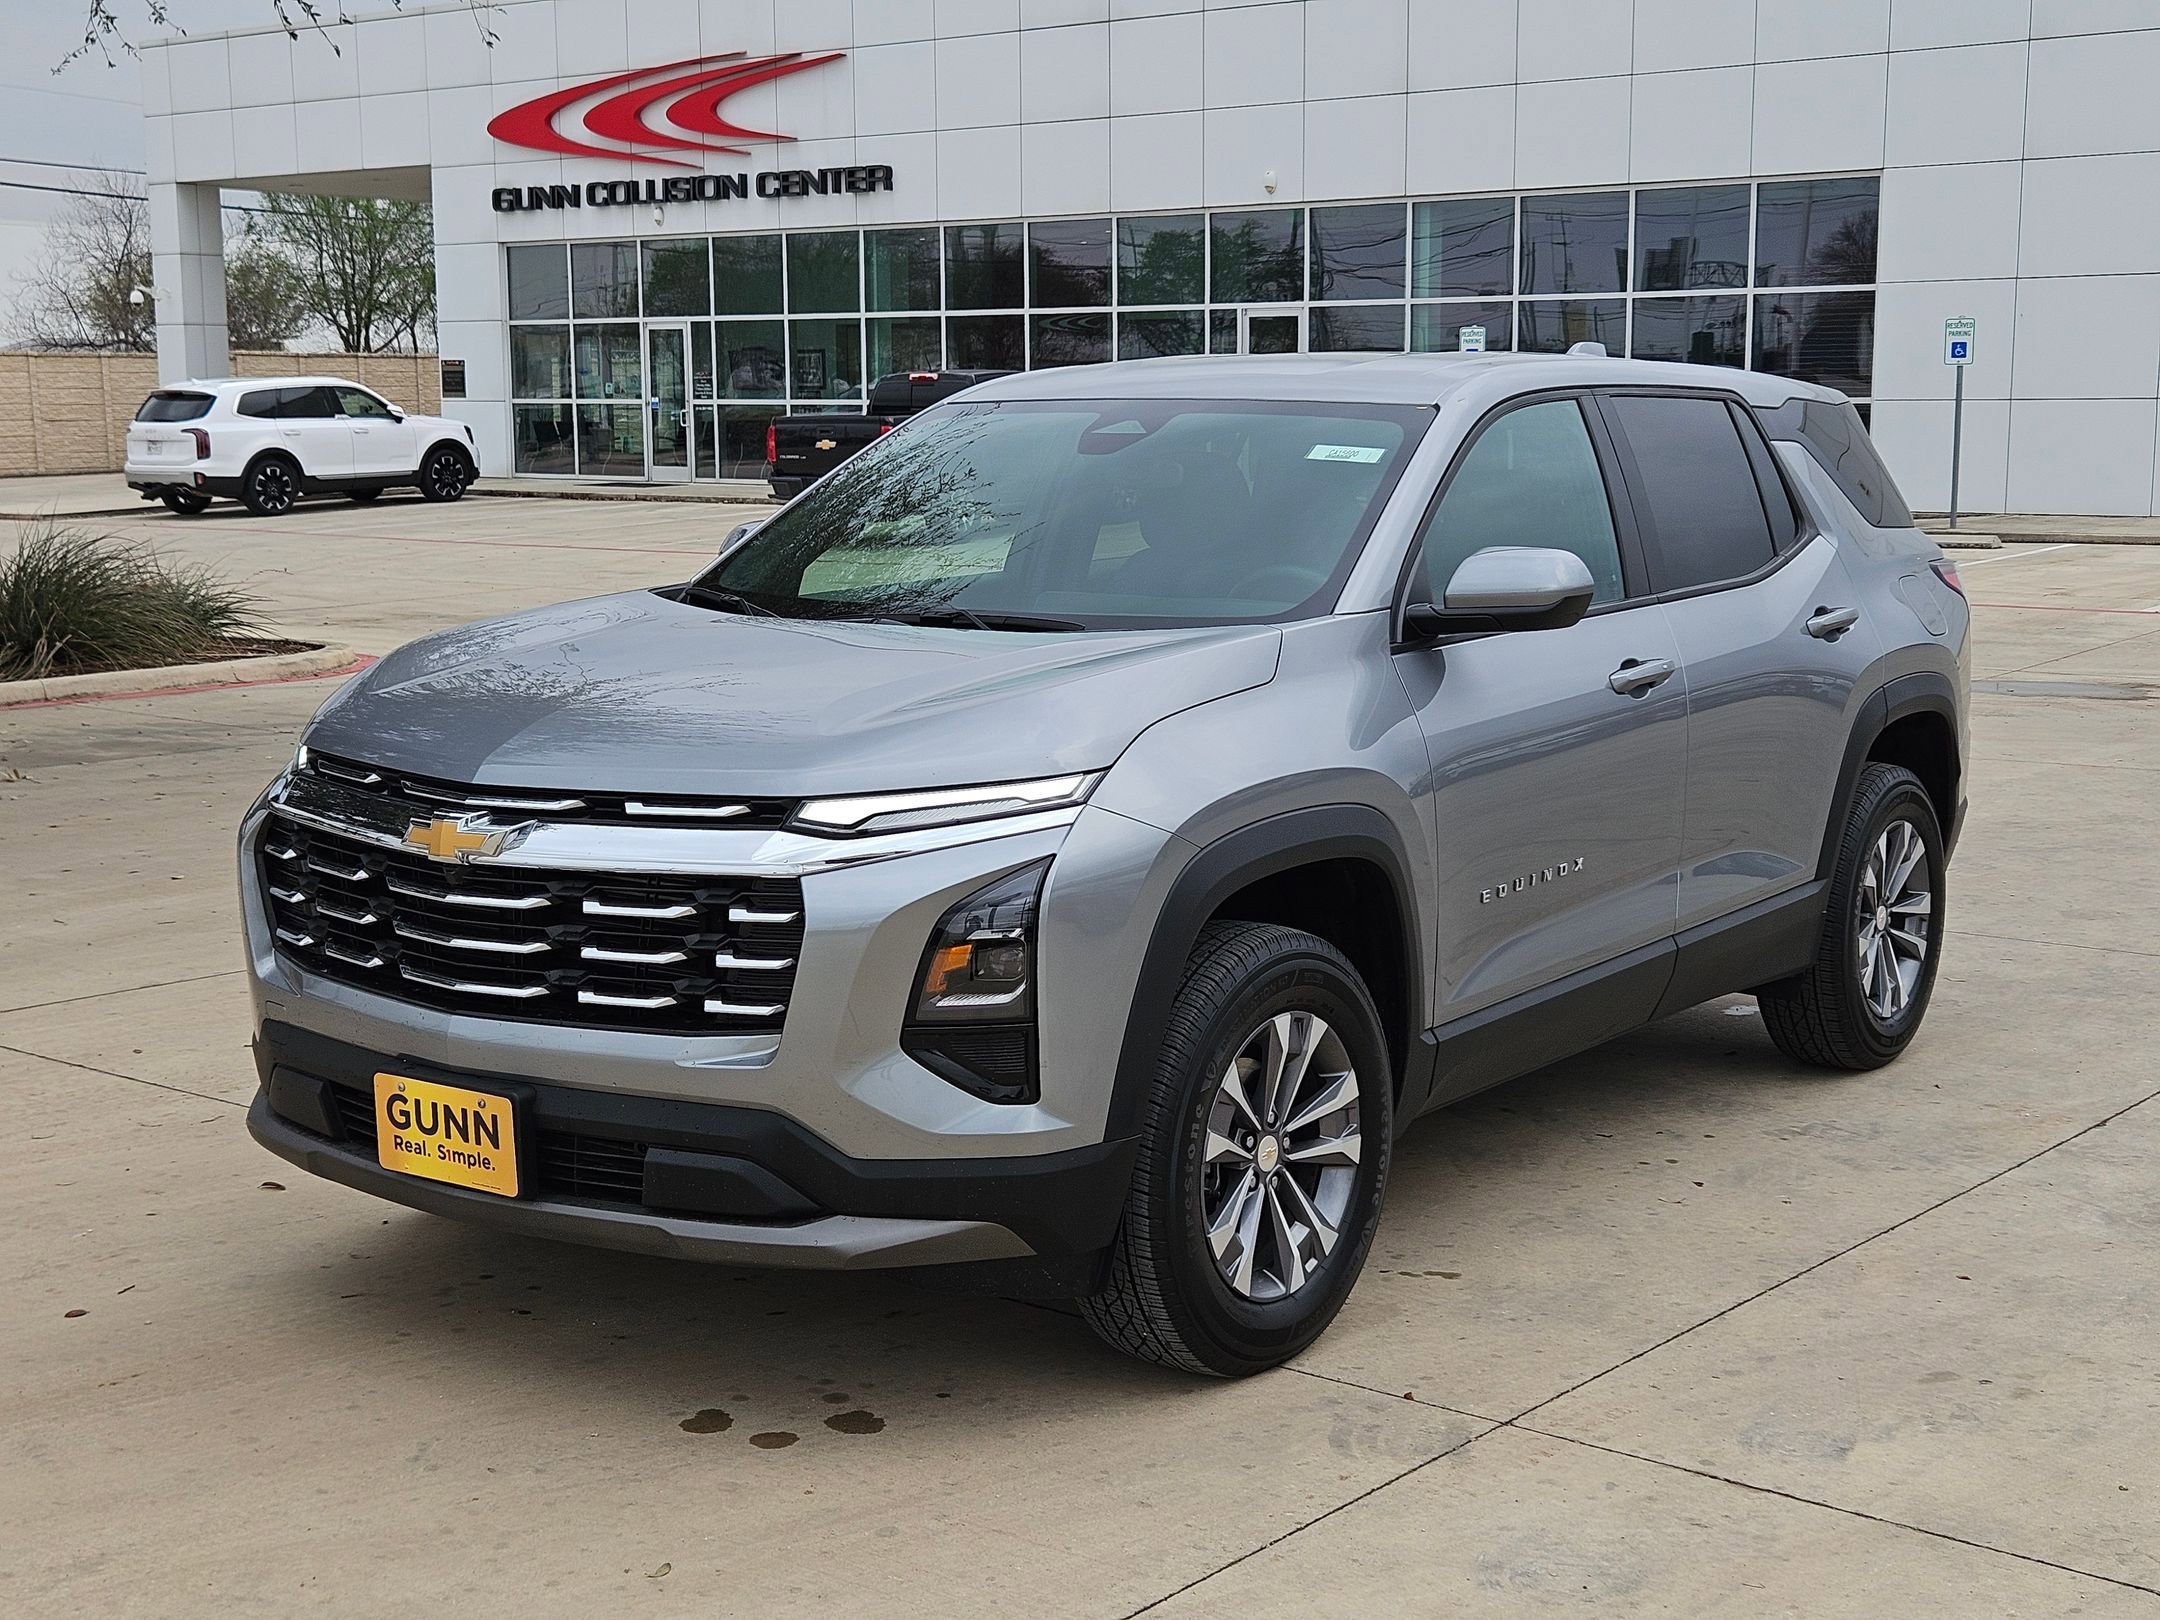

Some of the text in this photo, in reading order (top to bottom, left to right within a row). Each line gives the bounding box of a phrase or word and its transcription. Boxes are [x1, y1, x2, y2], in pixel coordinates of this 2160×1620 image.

[491, 164, 893, 213] GUNN COLLISION CENTER
[1480, 857, 1584, 904] EQUINOX
[386, 1093, 500, 1150] GUNN
[393, 1134, 431, 1158] Real.
